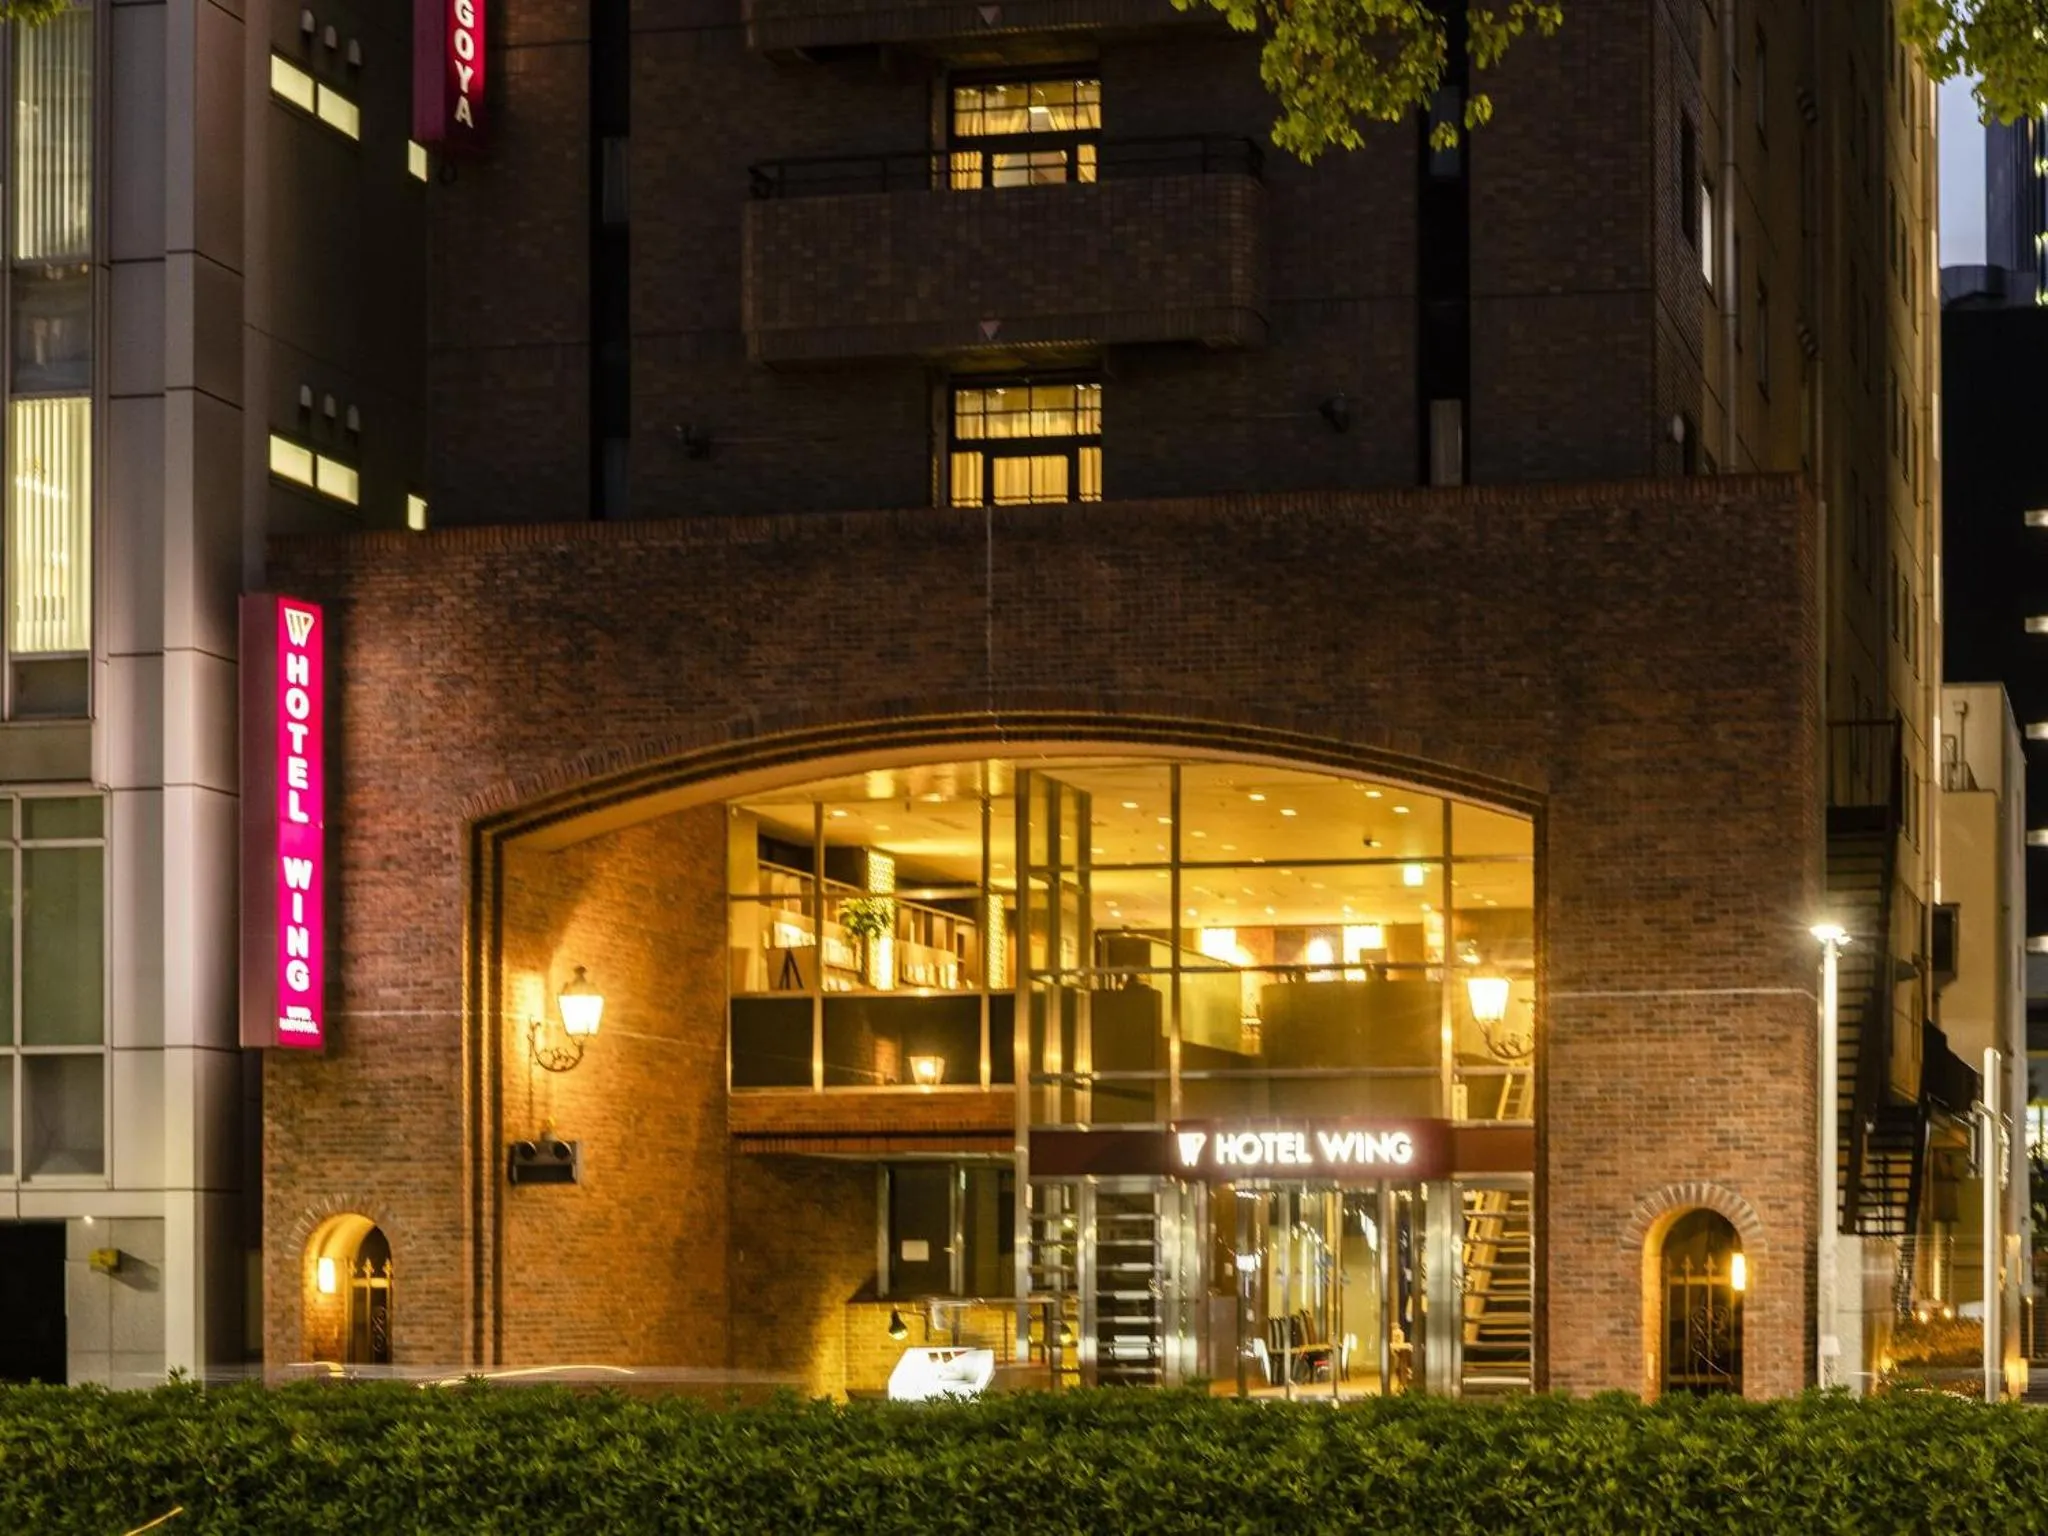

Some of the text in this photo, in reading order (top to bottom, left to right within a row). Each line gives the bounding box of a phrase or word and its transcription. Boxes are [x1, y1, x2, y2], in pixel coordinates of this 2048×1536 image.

[454, 0, 475, 128] GOYA
[285, 652, 310, 824] HOTEL
[282, 856, 313, 992] WING
[1215, 1131, 1313, 1165] HOTEL
[1316, 1131, 1413, 1165] WING
